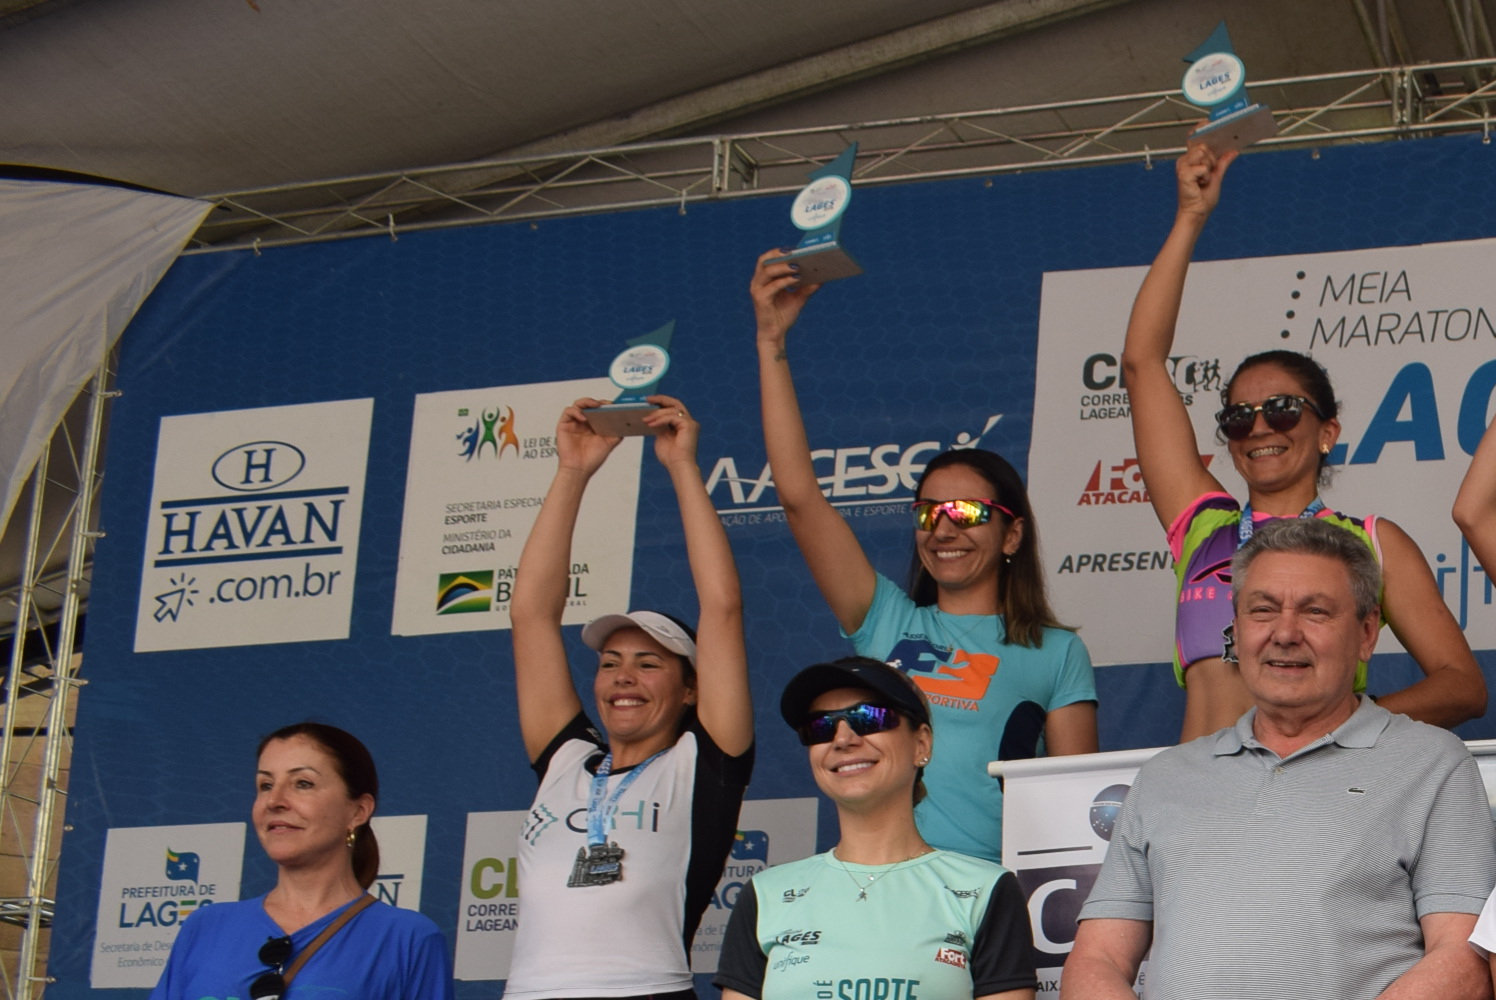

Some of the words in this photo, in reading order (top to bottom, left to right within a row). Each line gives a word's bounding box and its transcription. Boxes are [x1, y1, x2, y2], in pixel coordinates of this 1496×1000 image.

[1319, 271, 1413, 306] MEIA
[1080, 394, 1128, 407] CORRE
[240, 447, 276, 486] H
[444, 513, 487, 525] ESPORTE
[158, 500, 345, 555] HAVAN
[498, 529, 512, 539] DA
[441, 543, 495, 555] CIDADANIA
[209, 563, 341, 603] .com.br
[122, 886, 195, 899] PREFEITURA
[199, 884, 216, 896] DE
[468, 904, 517, 918] CORRE
[776, 931, 822, 945] LAGES
[940, 948, 966, 966] Fort
